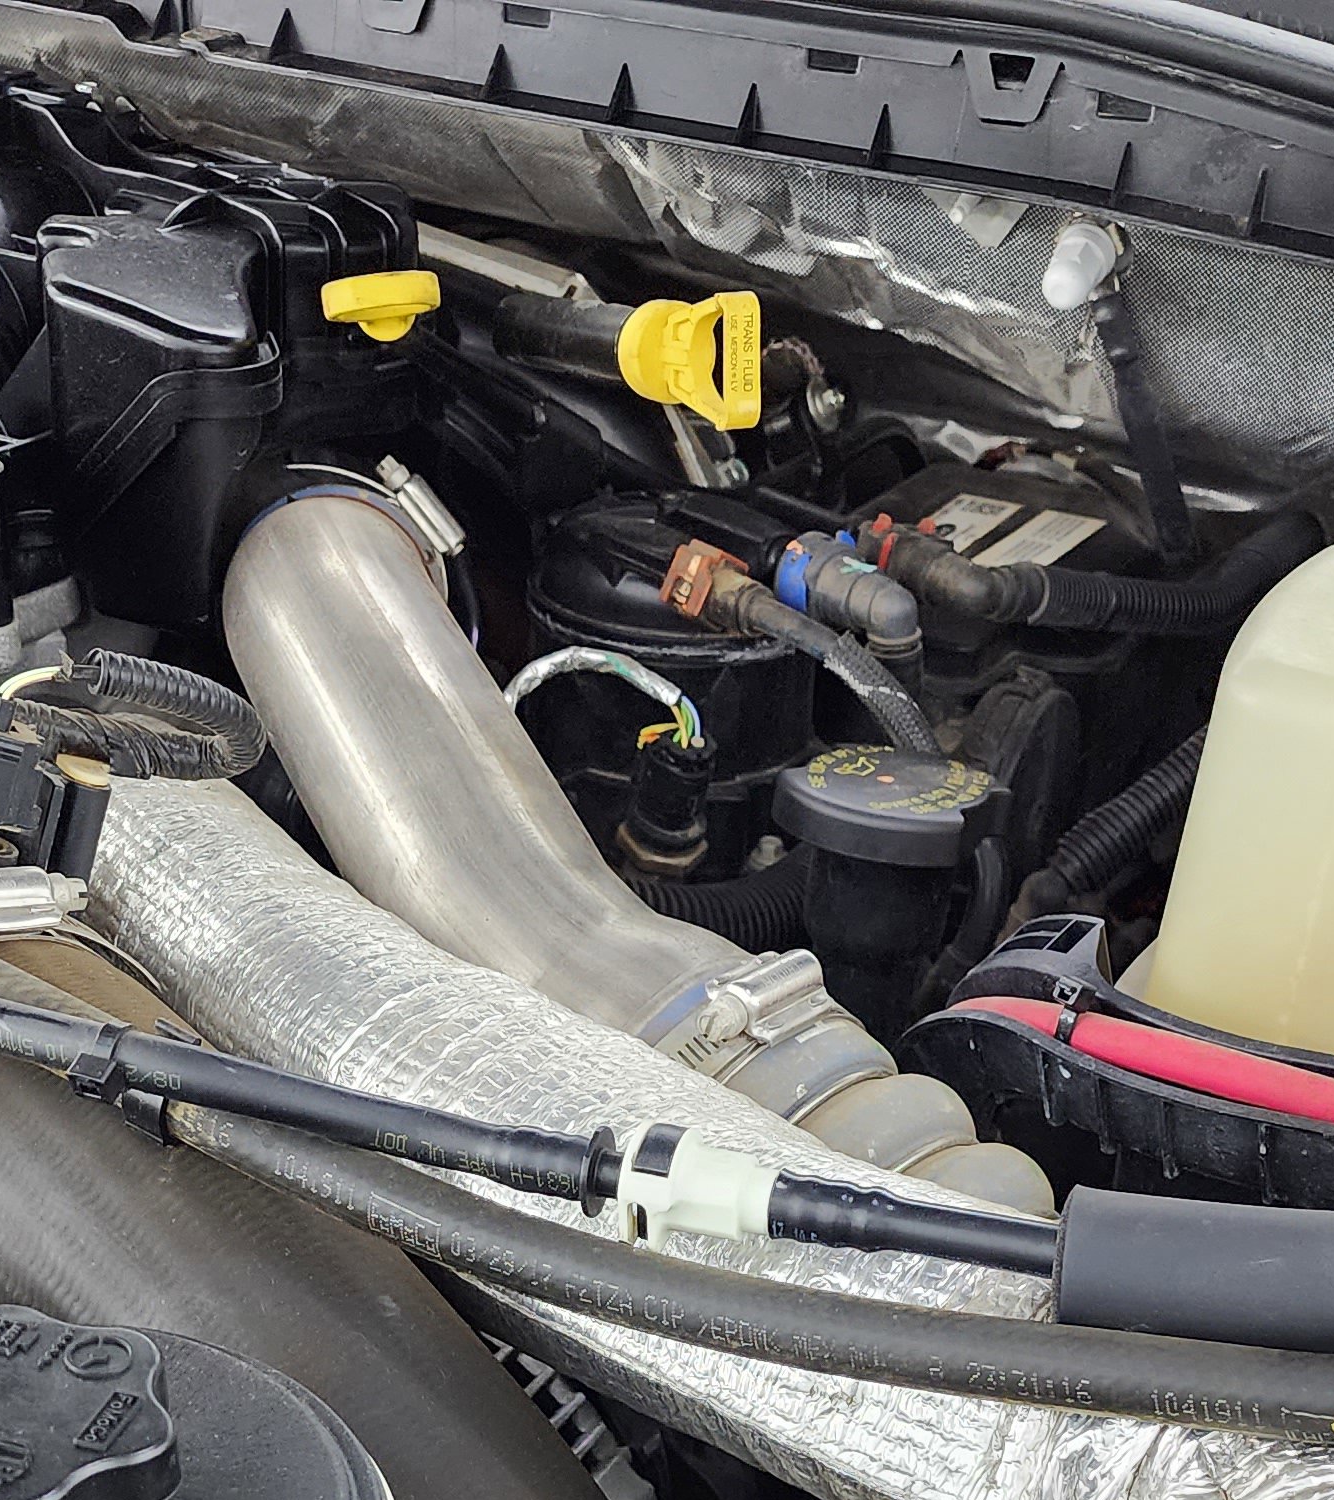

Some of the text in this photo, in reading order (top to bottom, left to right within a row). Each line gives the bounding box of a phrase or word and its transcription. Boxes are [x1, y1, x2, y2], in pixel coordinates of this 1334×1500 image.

[743, 312, 753, 392] TRANS FLUID
[730, 380, 737, 391] LV
[368, 1125, 411, 1154] DOT
[453, 1148, 504, 1179] TYPE
[83, 1392, 136, 1443] FoMoCo
